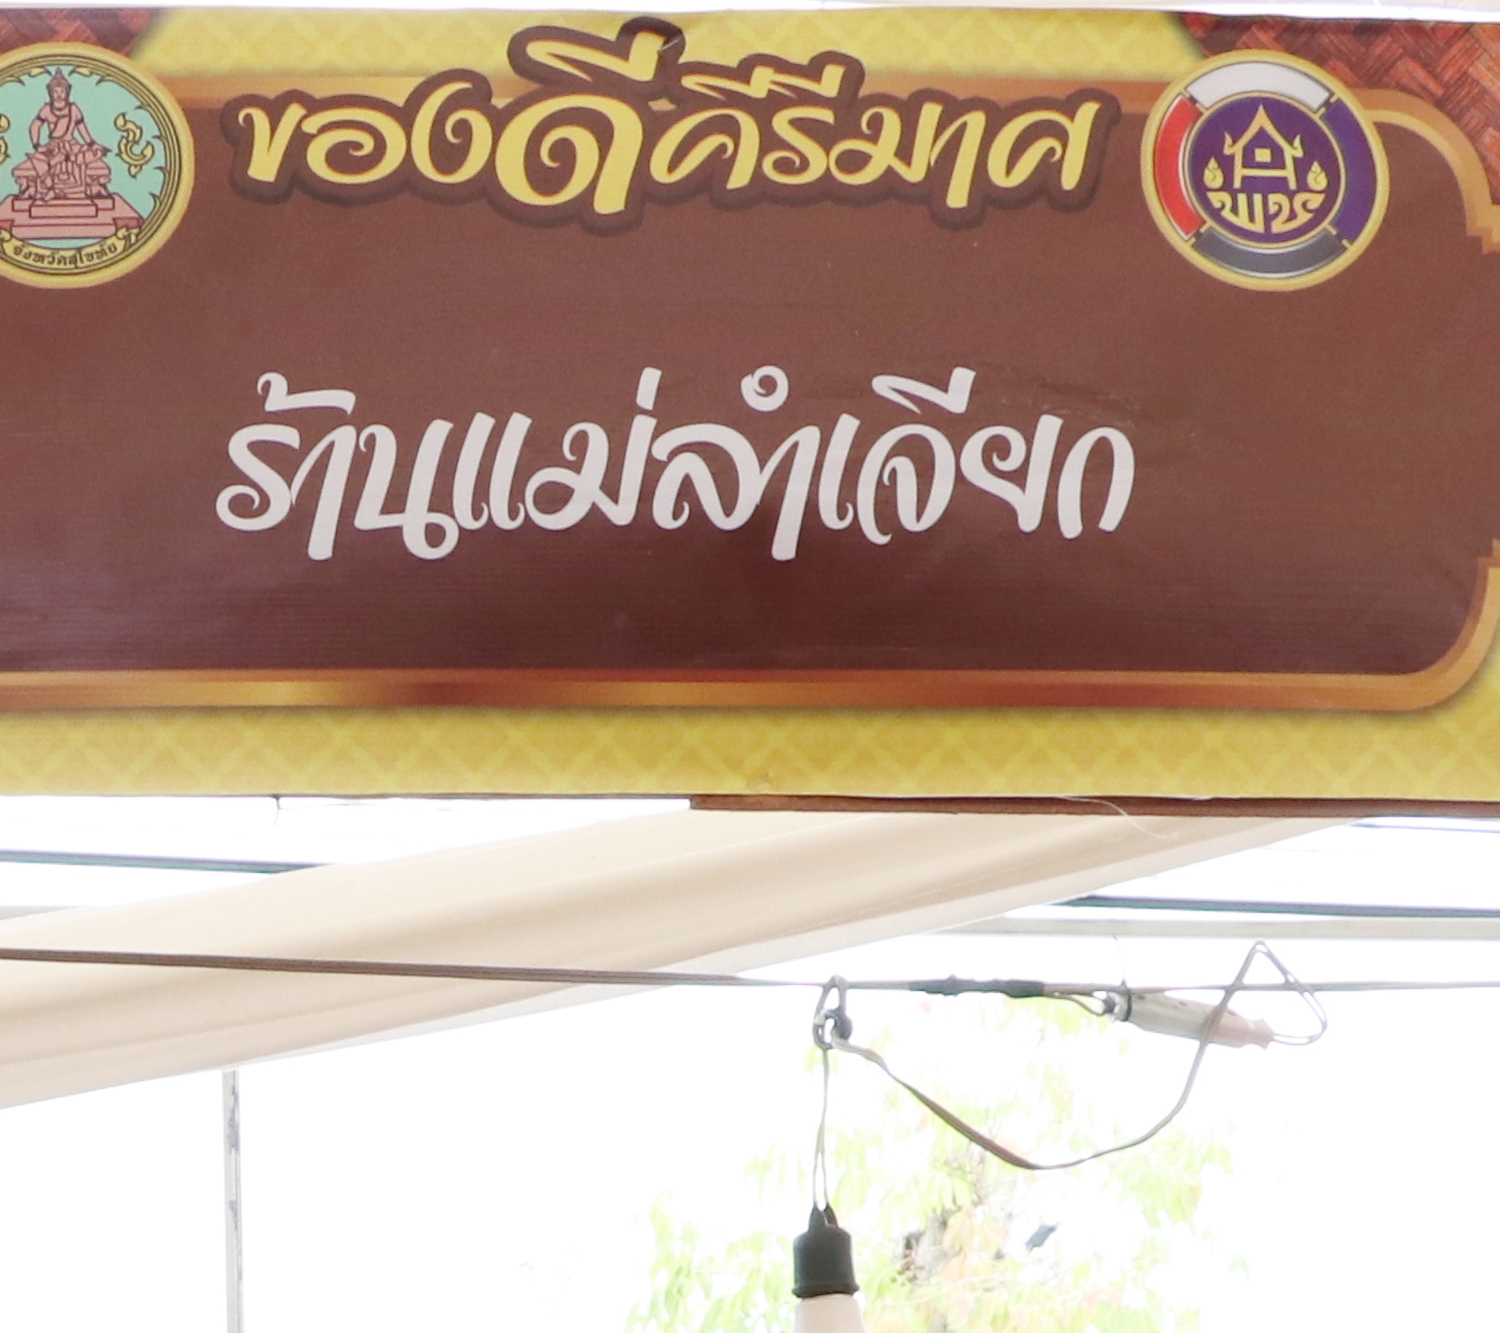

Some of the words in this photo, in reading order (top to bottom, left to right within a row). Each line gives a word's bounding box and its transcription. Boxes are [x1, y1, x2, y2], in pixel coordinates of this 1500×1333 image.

[215, 366, 1137, 561] ร้านแม่ลำเจียก
